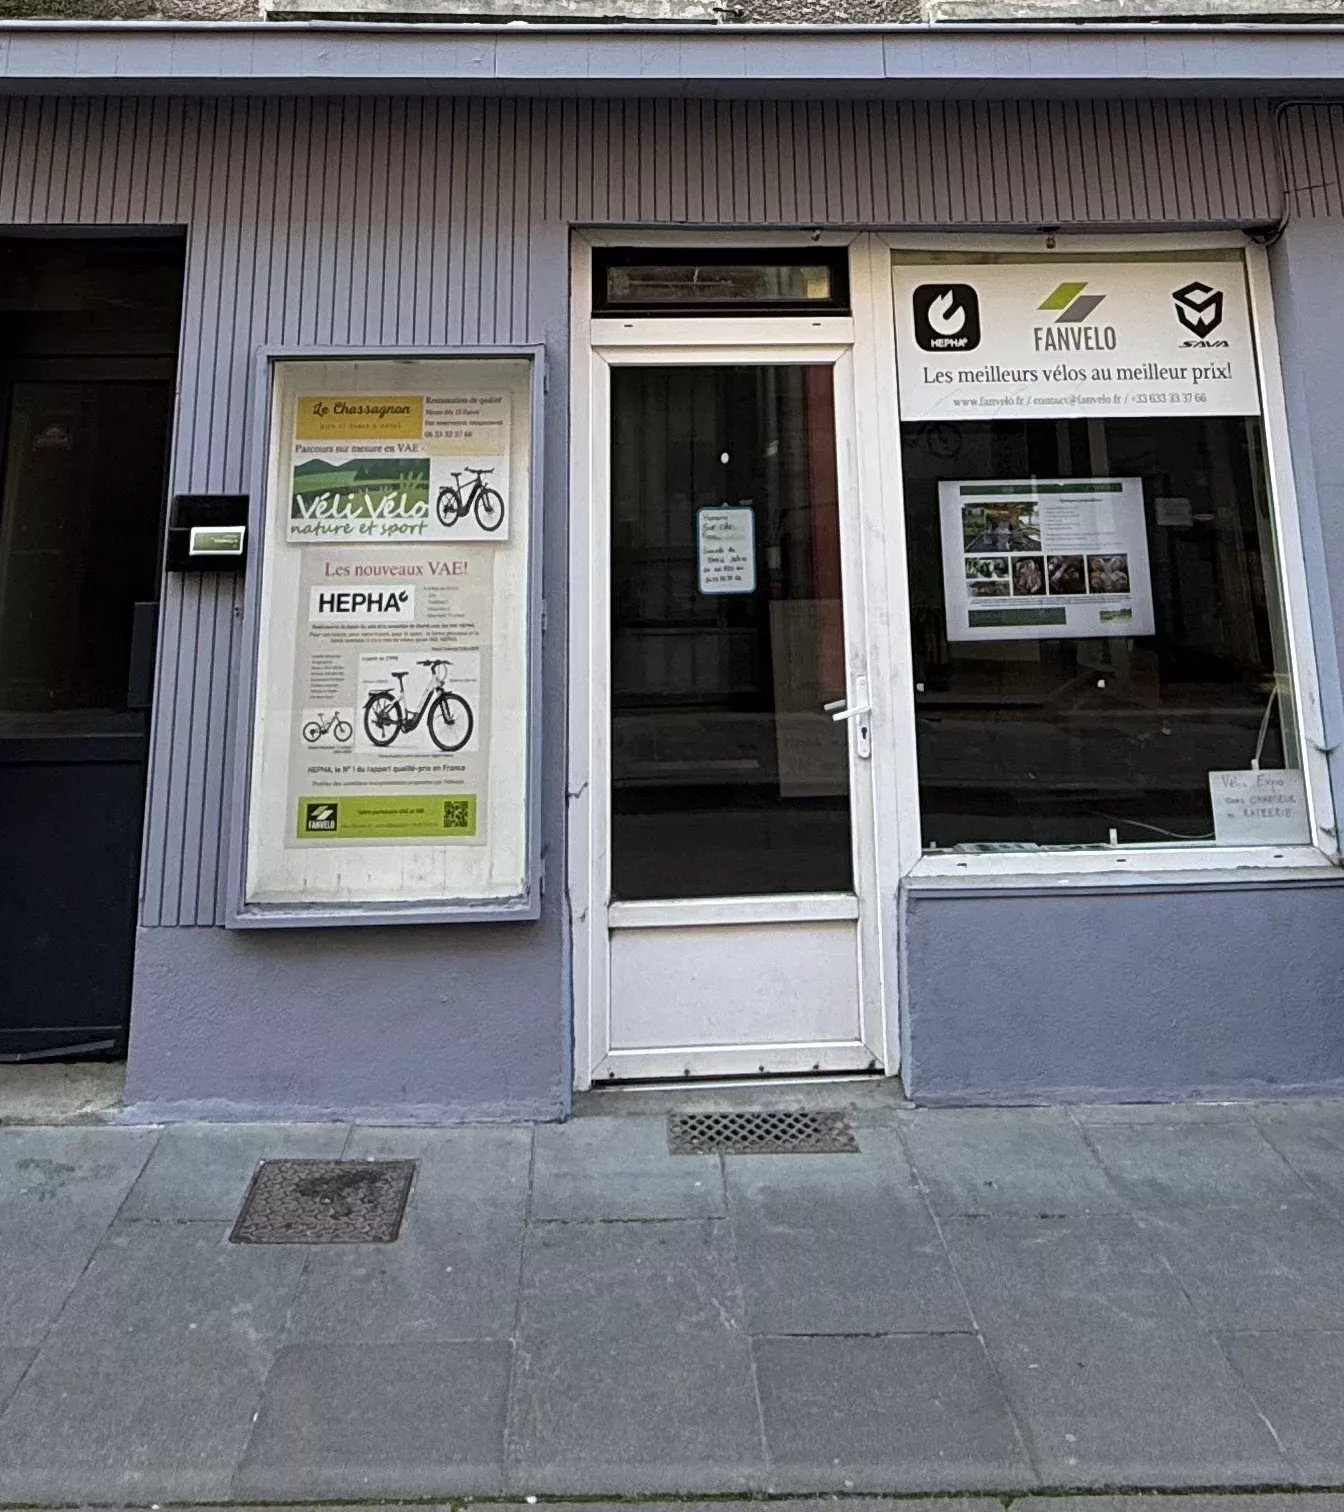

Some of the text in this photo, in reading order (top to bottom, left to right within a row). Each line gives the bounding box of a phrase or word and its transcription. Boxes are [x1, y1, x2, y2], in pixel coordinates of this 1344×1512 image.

[1034, 326, 1117, 352] FANVELO
[923, 362, 1232, 384] Les meilleurs vélos au meilleur prix!
[333, 402, 411, 418] Chassagnon
[295, 444, 334, 454] Parcours
[297, 490, 429, 523] Véli Vélo
[290, 520, 429, 536] nature et sport
[325, 561, 468, 577] Les nouveaux VAE!
[319, 592, 403, 613] HEPHA
